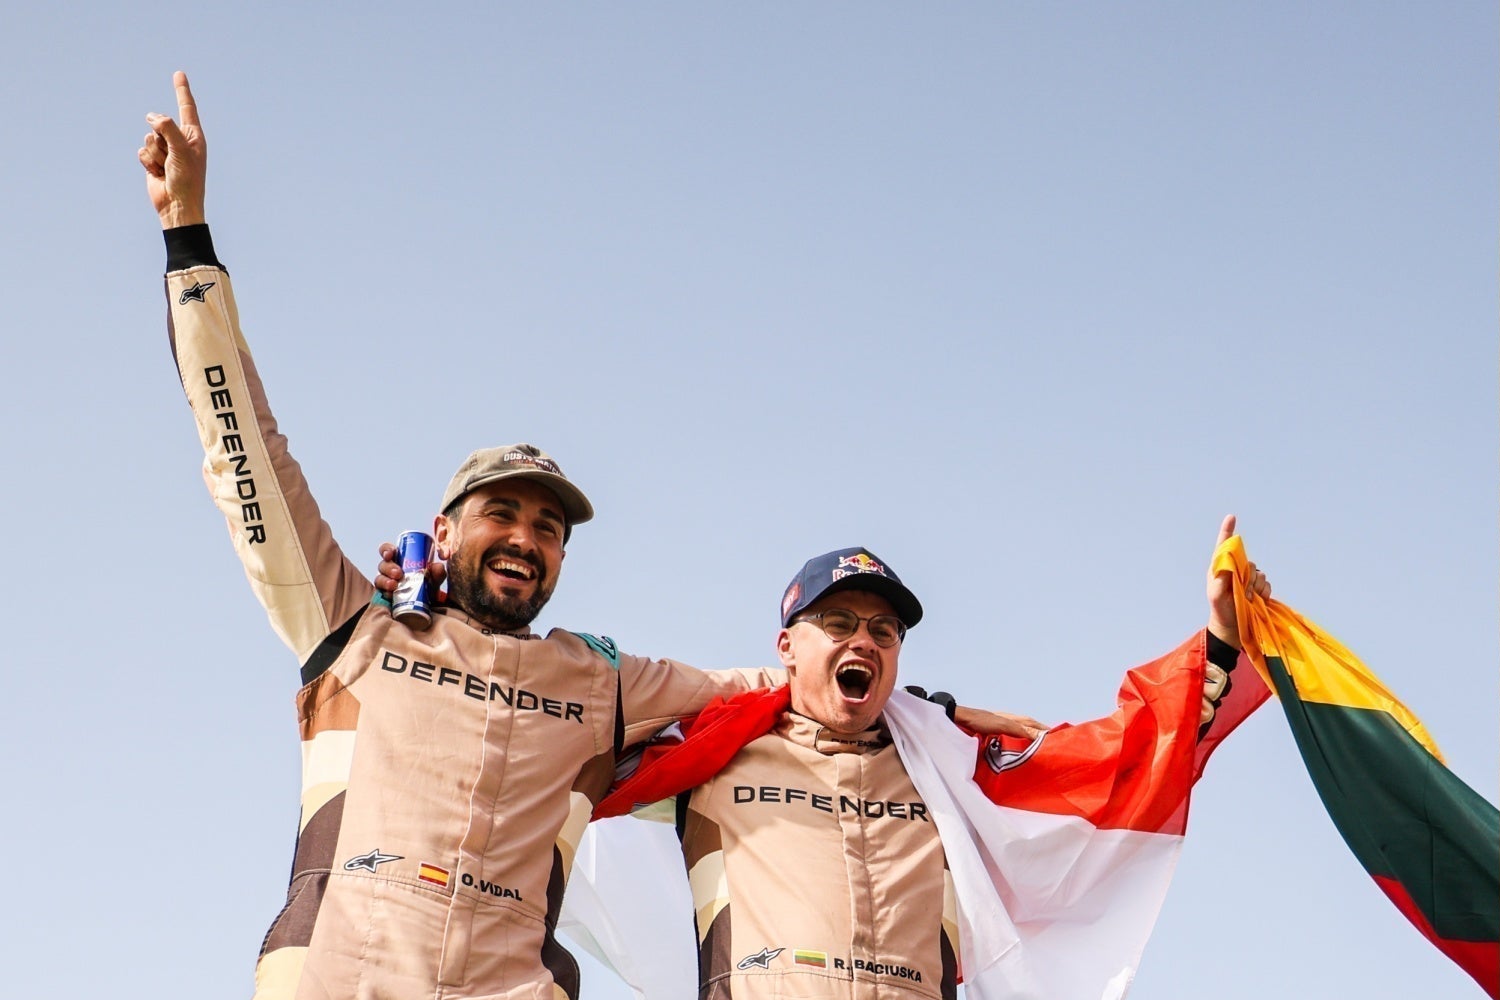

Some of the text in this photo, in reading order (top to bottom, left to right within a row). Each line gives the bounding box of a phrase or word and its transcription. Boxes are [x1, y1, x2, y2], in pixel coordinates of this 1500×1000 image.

[204, 364, 267, 545] DEFENDER
[381, 651, 584, 725] DEFENDER
[733, 786, 929, 823] DEFENDER
[854, 959, 923, 983] BACIUSKA
